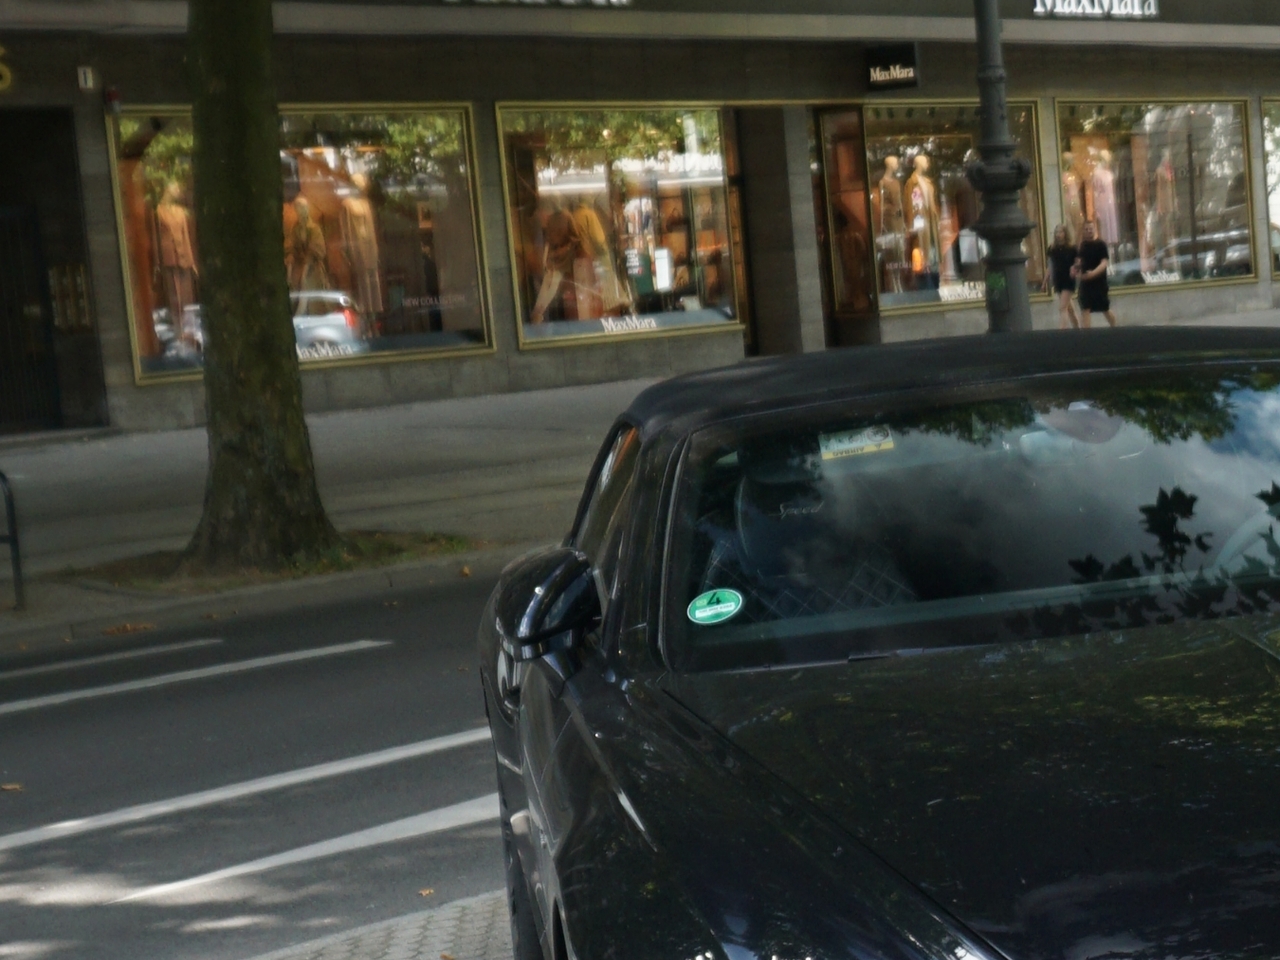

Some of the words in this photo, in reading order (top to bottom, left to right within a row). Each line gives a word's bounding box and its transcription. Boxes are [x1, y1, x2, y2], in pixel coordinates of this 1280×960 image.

[869, 64, 914, 82] MaxMara
[600, 315, 657, 332] MaxMara
[707, 591, 722, 606] 4
